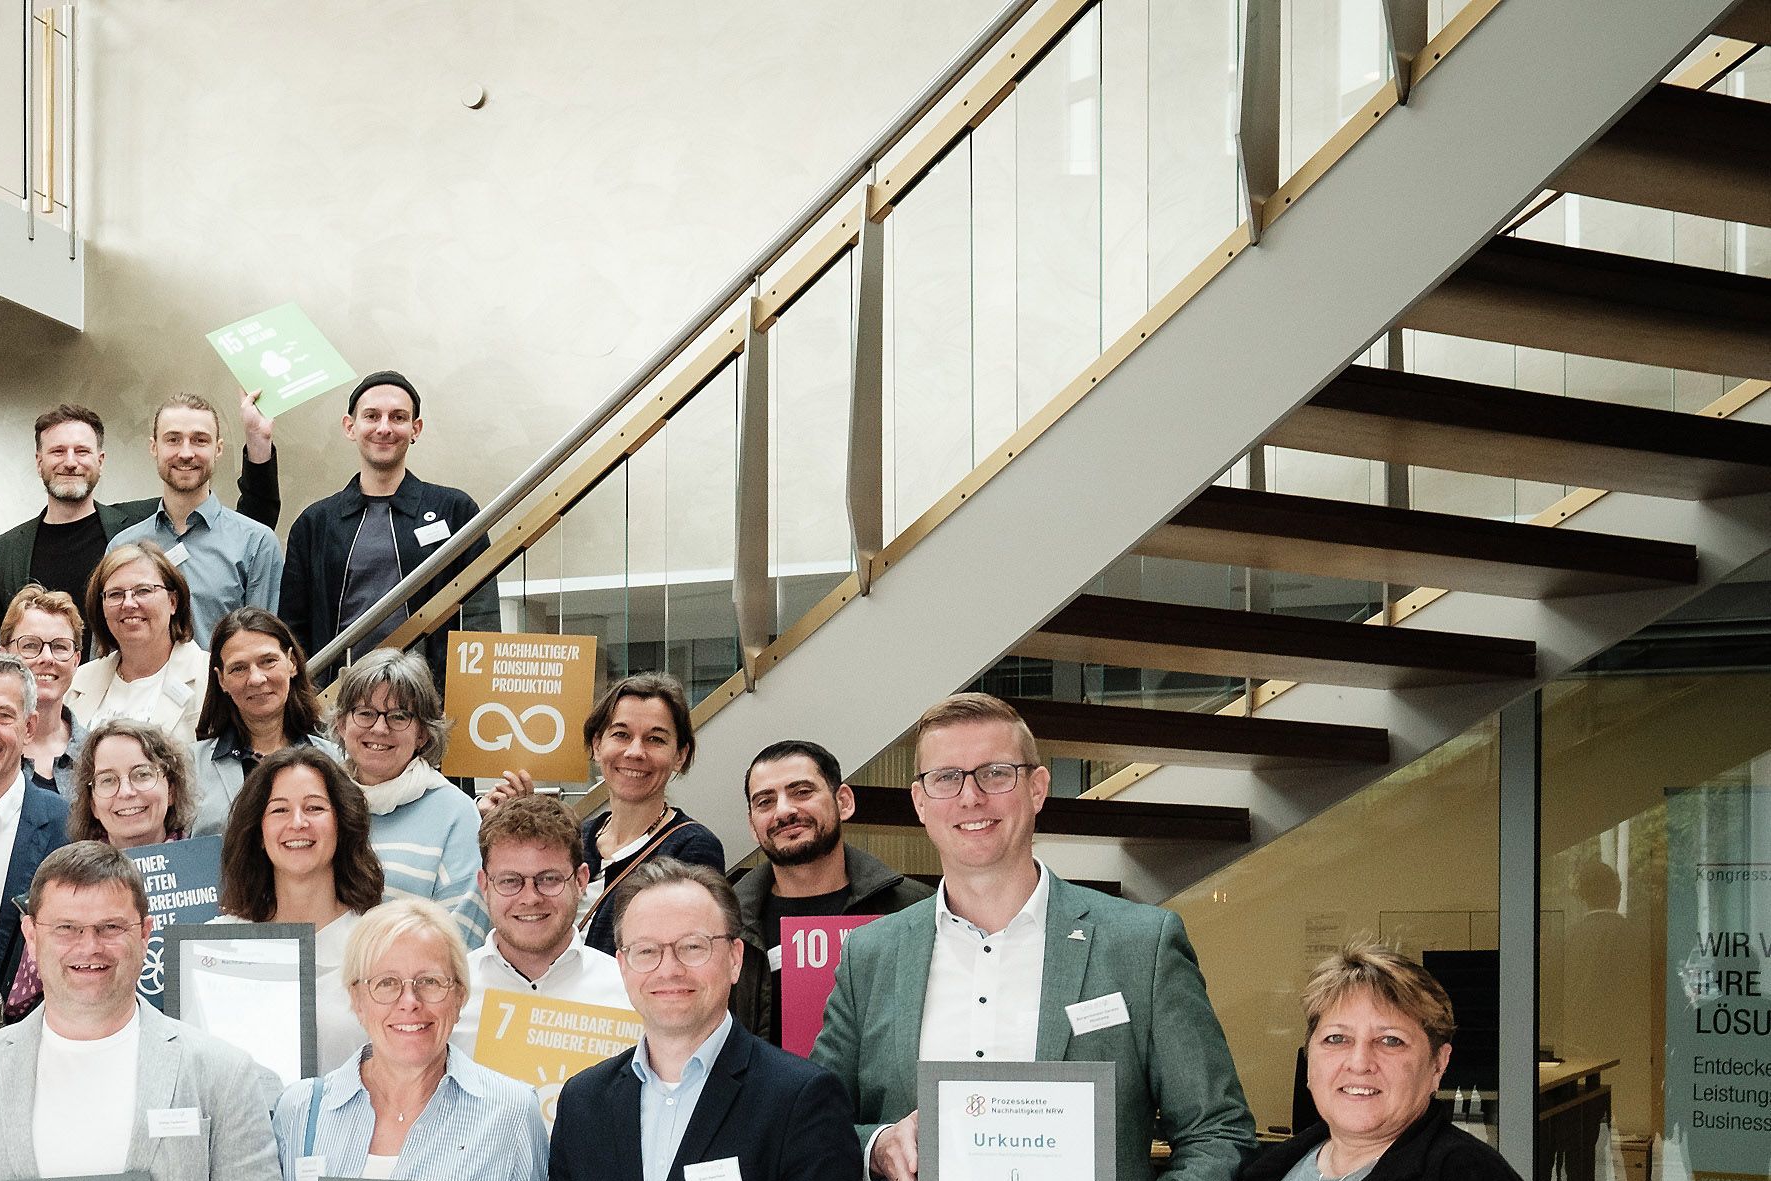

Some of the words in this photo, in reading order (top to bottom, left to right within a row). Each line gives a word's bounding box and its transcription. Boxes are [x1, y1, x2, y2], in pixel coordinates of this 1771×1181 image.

[218, 332, 245, 355] 15
[457, 642, 484, 674] 12
[494, 643, 580, 661] NACHHALTIGE/R
[493, 660, 539, 676] KONSUM
[541, 662, 564, 677] UND
[492, 677, 562, 694] PRODUKTION
[132, 854, 170, 874] TNER-
[792, 928, 828, 969] 10
[1696, 931, 1750, 958] WIR
[1696, 970, 1762, 997] IHRE
[495, 1002, 516, 1040] 7
[530, 1007, 614, 1036] BEZAHLBARE
[616, 1021, 645, 1041] UND
[1696, 1003, 1771, 1036] LÖSU
[526, 1028, 586, 1053] SAUBERE
[991, 1096, 1048, 1105] Prozesskette
[1692, 1083, 1771, 1108] Leistung
[991, 1106, 1044, 1115] Nachhaltigkeit
[1045, 1107, 1064, 1115] NRW
[974, 1133, 1057, 1148] Urkunde
